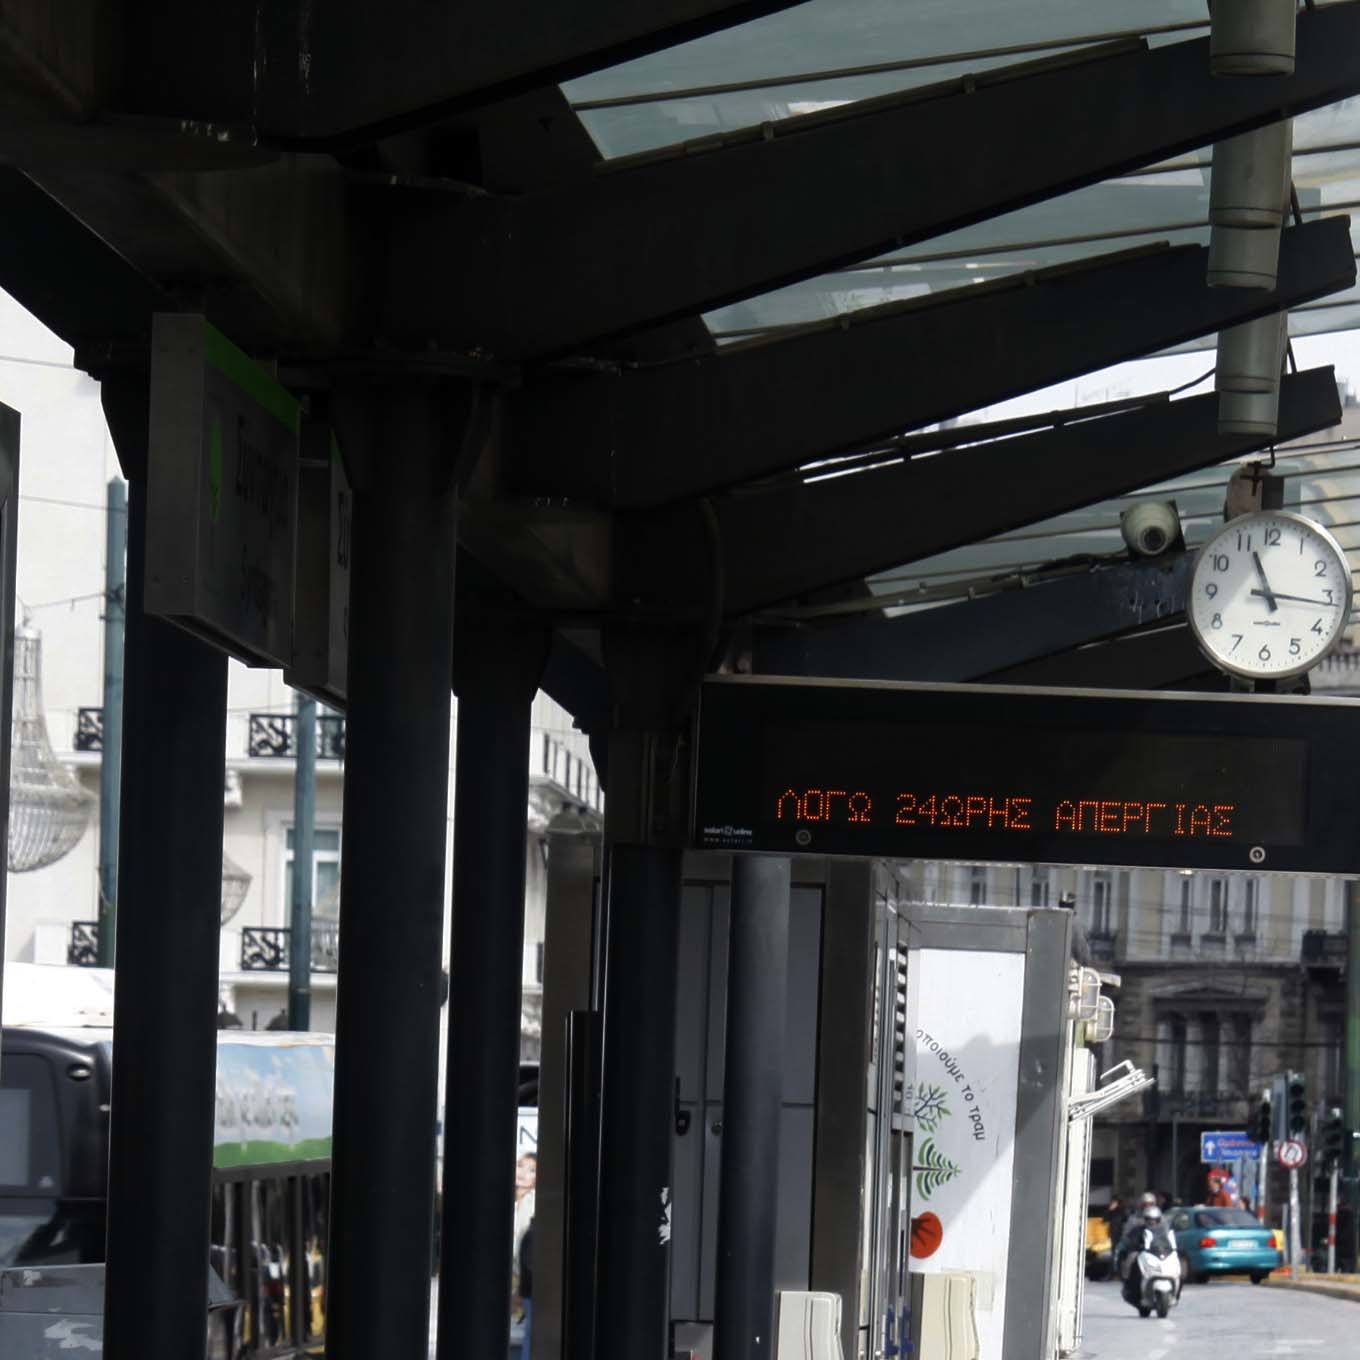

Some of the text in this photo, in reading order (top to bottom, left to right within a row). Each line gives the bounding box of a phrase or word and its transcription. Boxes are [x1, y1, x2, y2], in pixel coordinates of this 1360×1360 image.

[1237, 534, 1251, 552] 11
[1264, 527, 1281, 546] 12
[1213, 554, 1229, 571] 10
[1314, 560, 1328, 577] 2
[1205, 583, 1218, 600] 9
[1321, 589, 1334, 606] 3
[1210, 612, 1223, 630] 8
[1310, 618, 1324, 636] 4
[1231, 634, 1244, 651] 7
[1288, 638, 1302, 655] 5
[1258, 644, 1271, 661] 6
[776, 788, 1235, 836] ΛΟΓΩ 24ΩΡΗΣ ΑΠΕΡΓΙΑΣ
